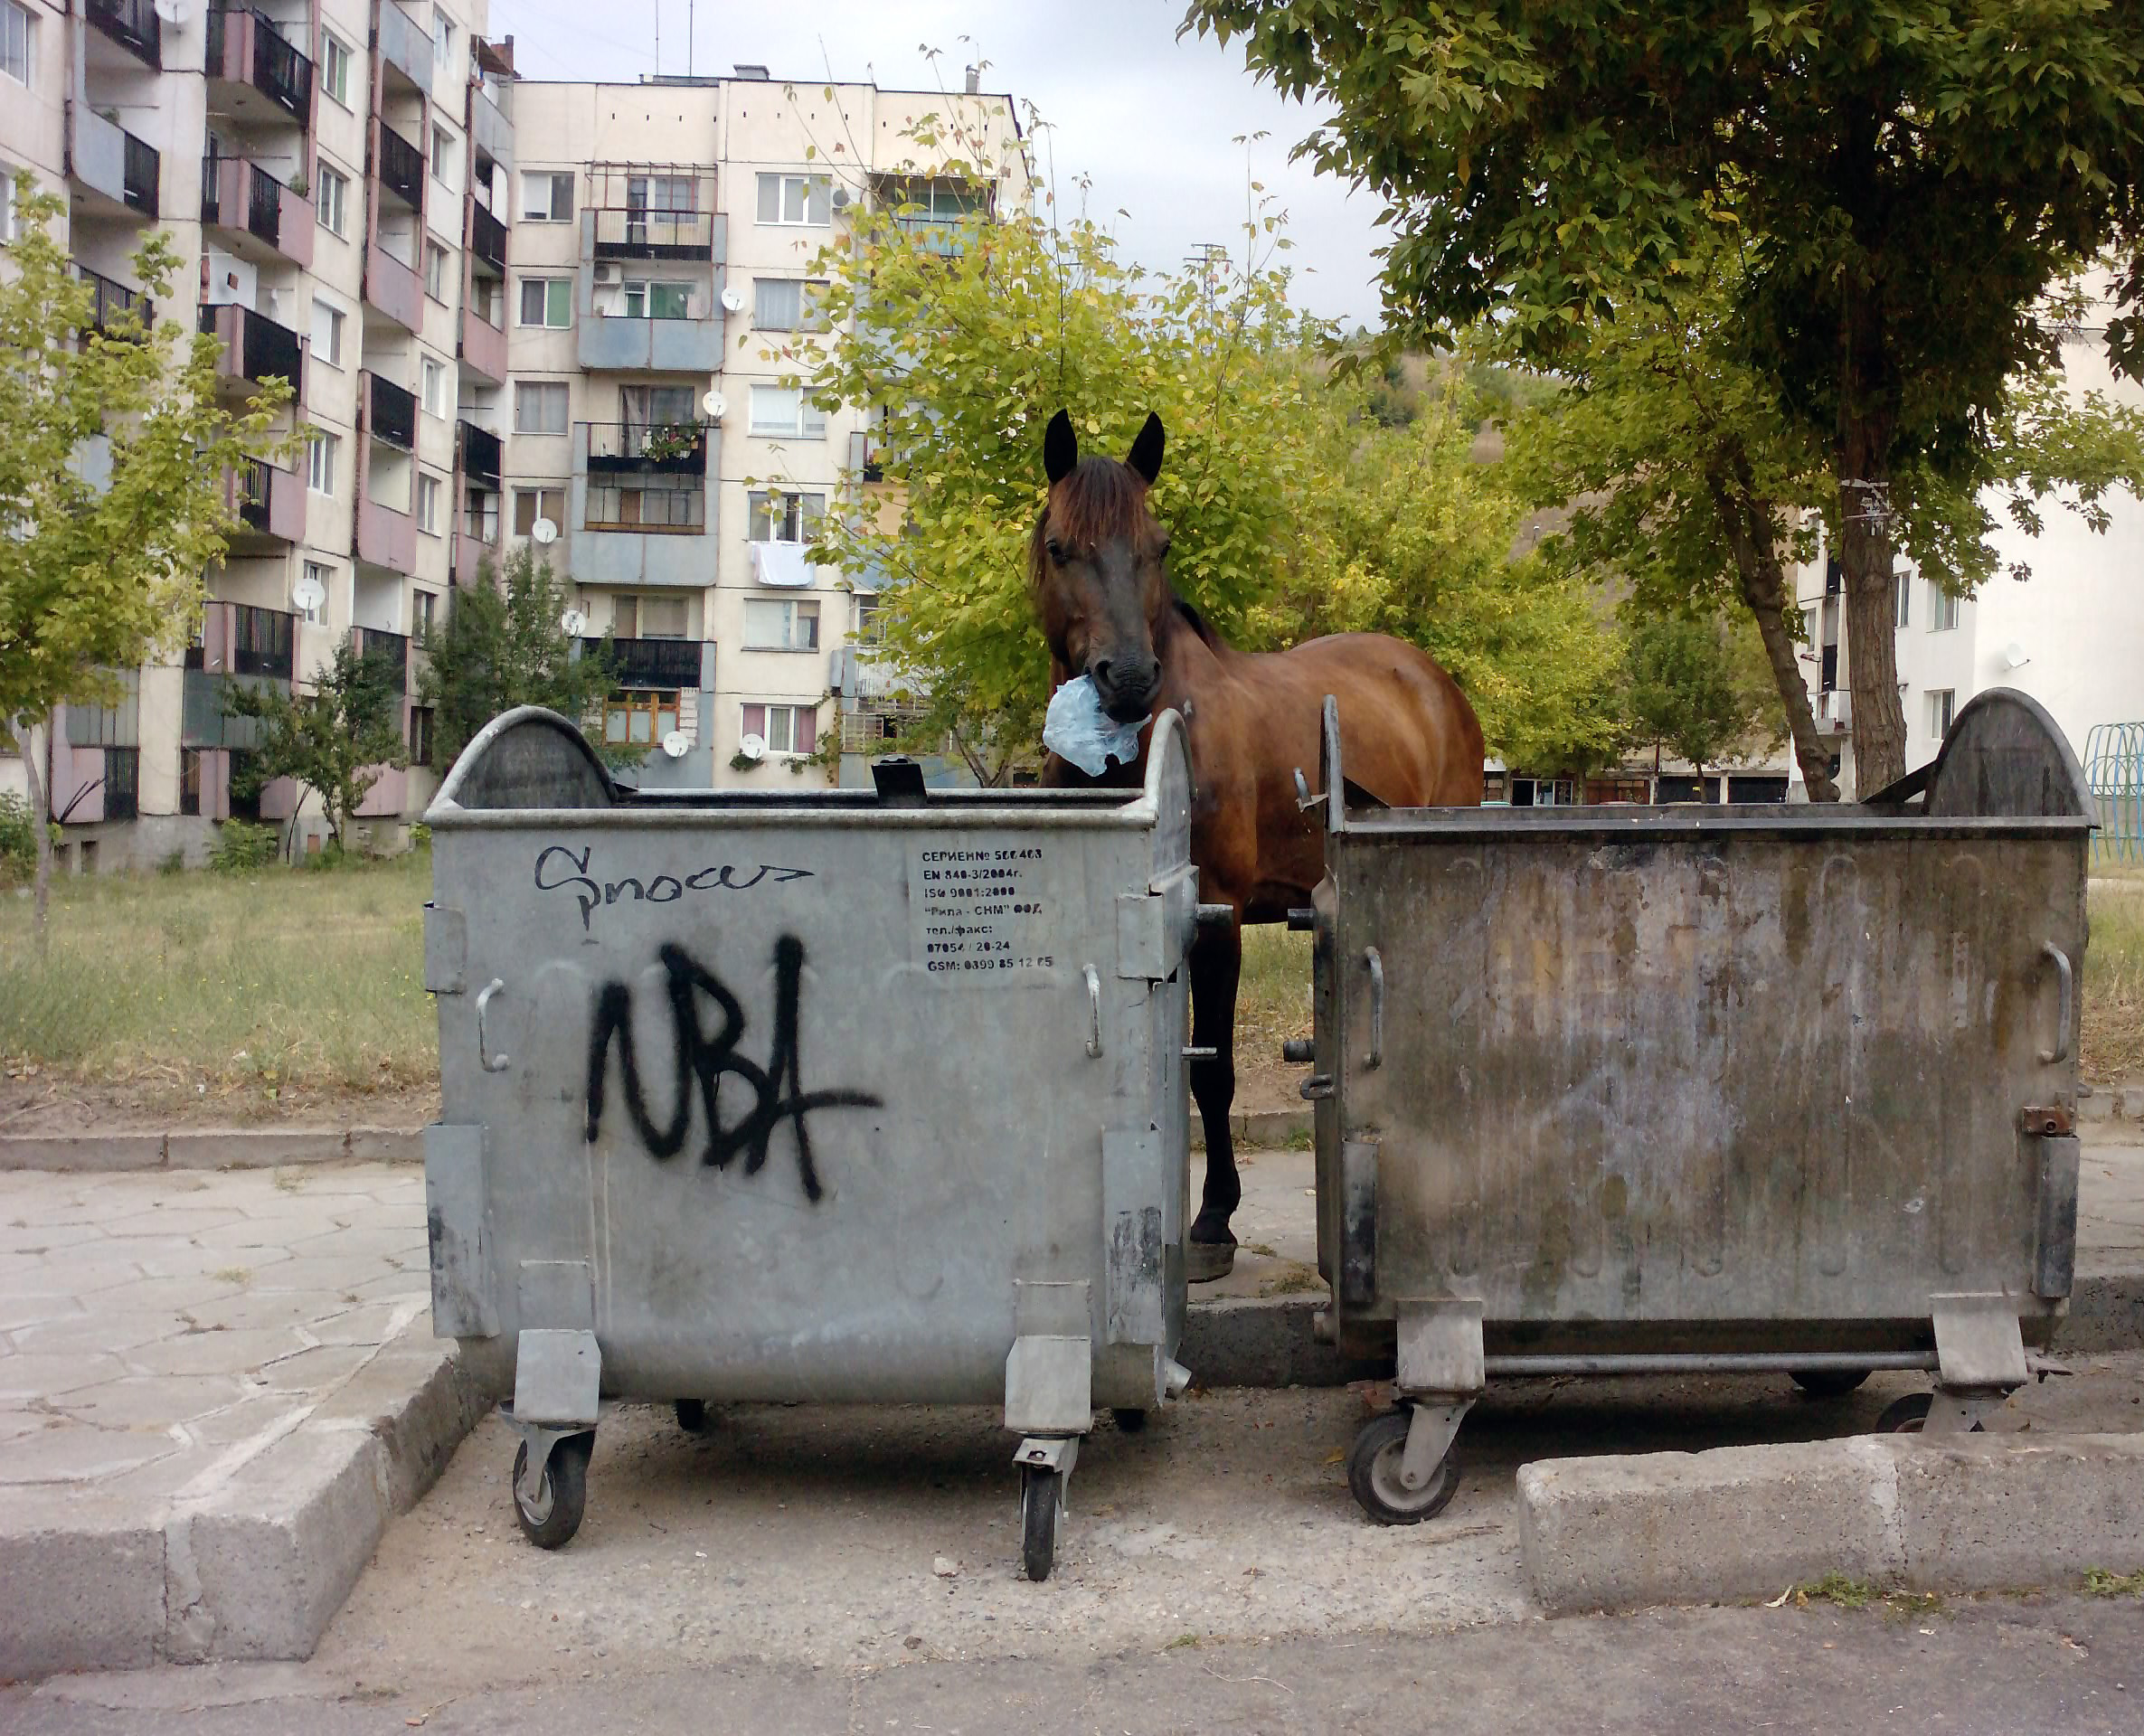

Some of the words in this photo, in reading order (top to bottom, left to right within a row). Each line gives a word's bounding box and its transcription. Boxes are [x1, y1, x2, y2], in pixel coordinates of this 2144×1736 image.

[923, 870, 940, 880] EN
[949, 886, 1015, 898] 9001:2000
[976, 940, 1010, 952] 20-24
[928, 959, 960, 972] GSM:
[998, 958, 1014, 968] 85
[1018, 957, 1034, 967] 12
